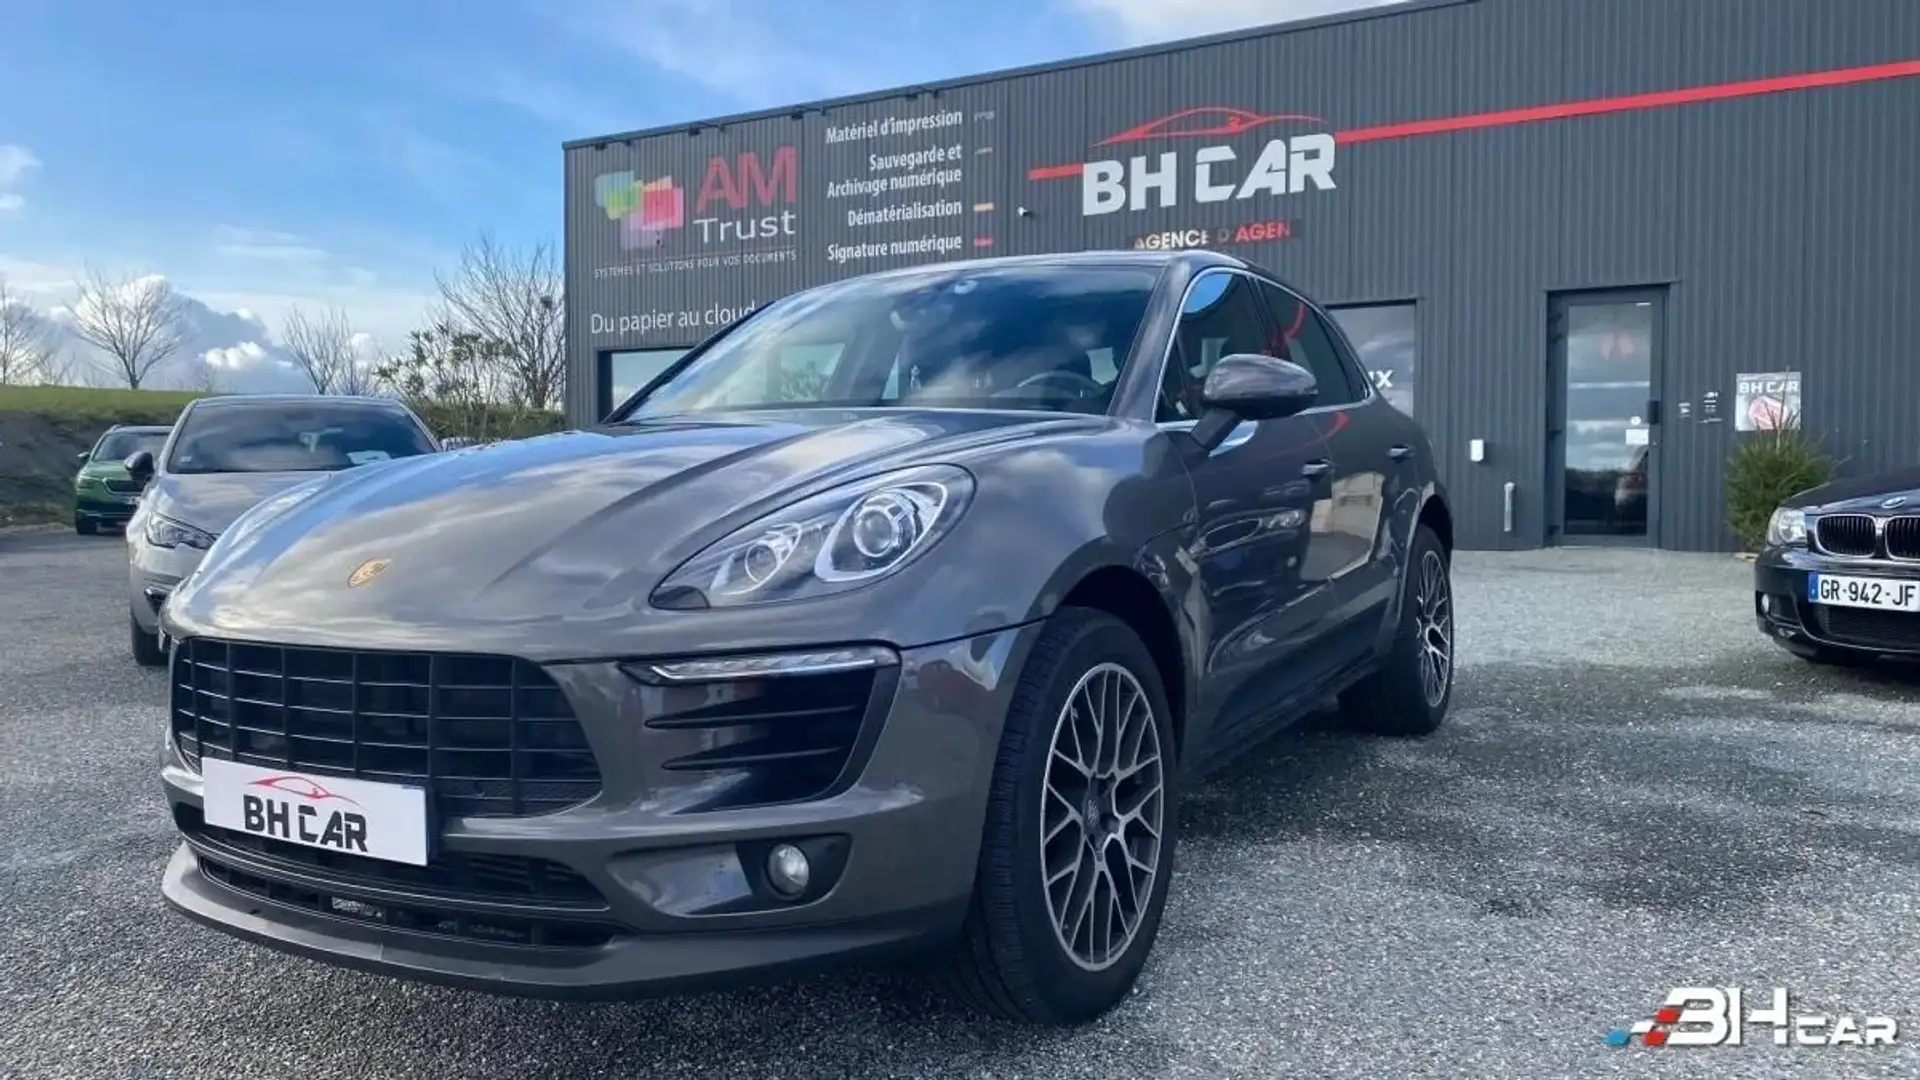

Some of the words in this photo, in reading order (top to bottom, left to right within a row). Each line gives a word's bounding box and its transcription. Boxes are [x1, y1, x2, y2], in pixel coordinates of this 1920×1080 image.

[825, 120, 877, 144] Matériel
[880, 109, 963, 136] d'impression
[869, 145, 945, 171] Sauvegarde
[947, 144, 962, 160] et
[695, 146, 797, 213] AM
[827, 178, 888, 199] Archivage
[890, 167, 962, 190] numérique
[1082, 152, 1177, 216] BH
[1195, 133, 1338, 203] CAR
[693, 210, 796, 245] Trust
[848, 199, 962, 227] Dématérialisation
[827, 242, 888, 264] Signature
[890, 234, 962, 255] numérique
[591, 313, 615, 334] Du
[618, 309, 675, 339] papier
[678, 308, 700, 327] au
[1740, 382, 1763, 393] BH
[1820, 579, 1917, 606] GR-942-JF
[243, 794, 290, 839] BH
[298, 804, 368, 852] CAR
